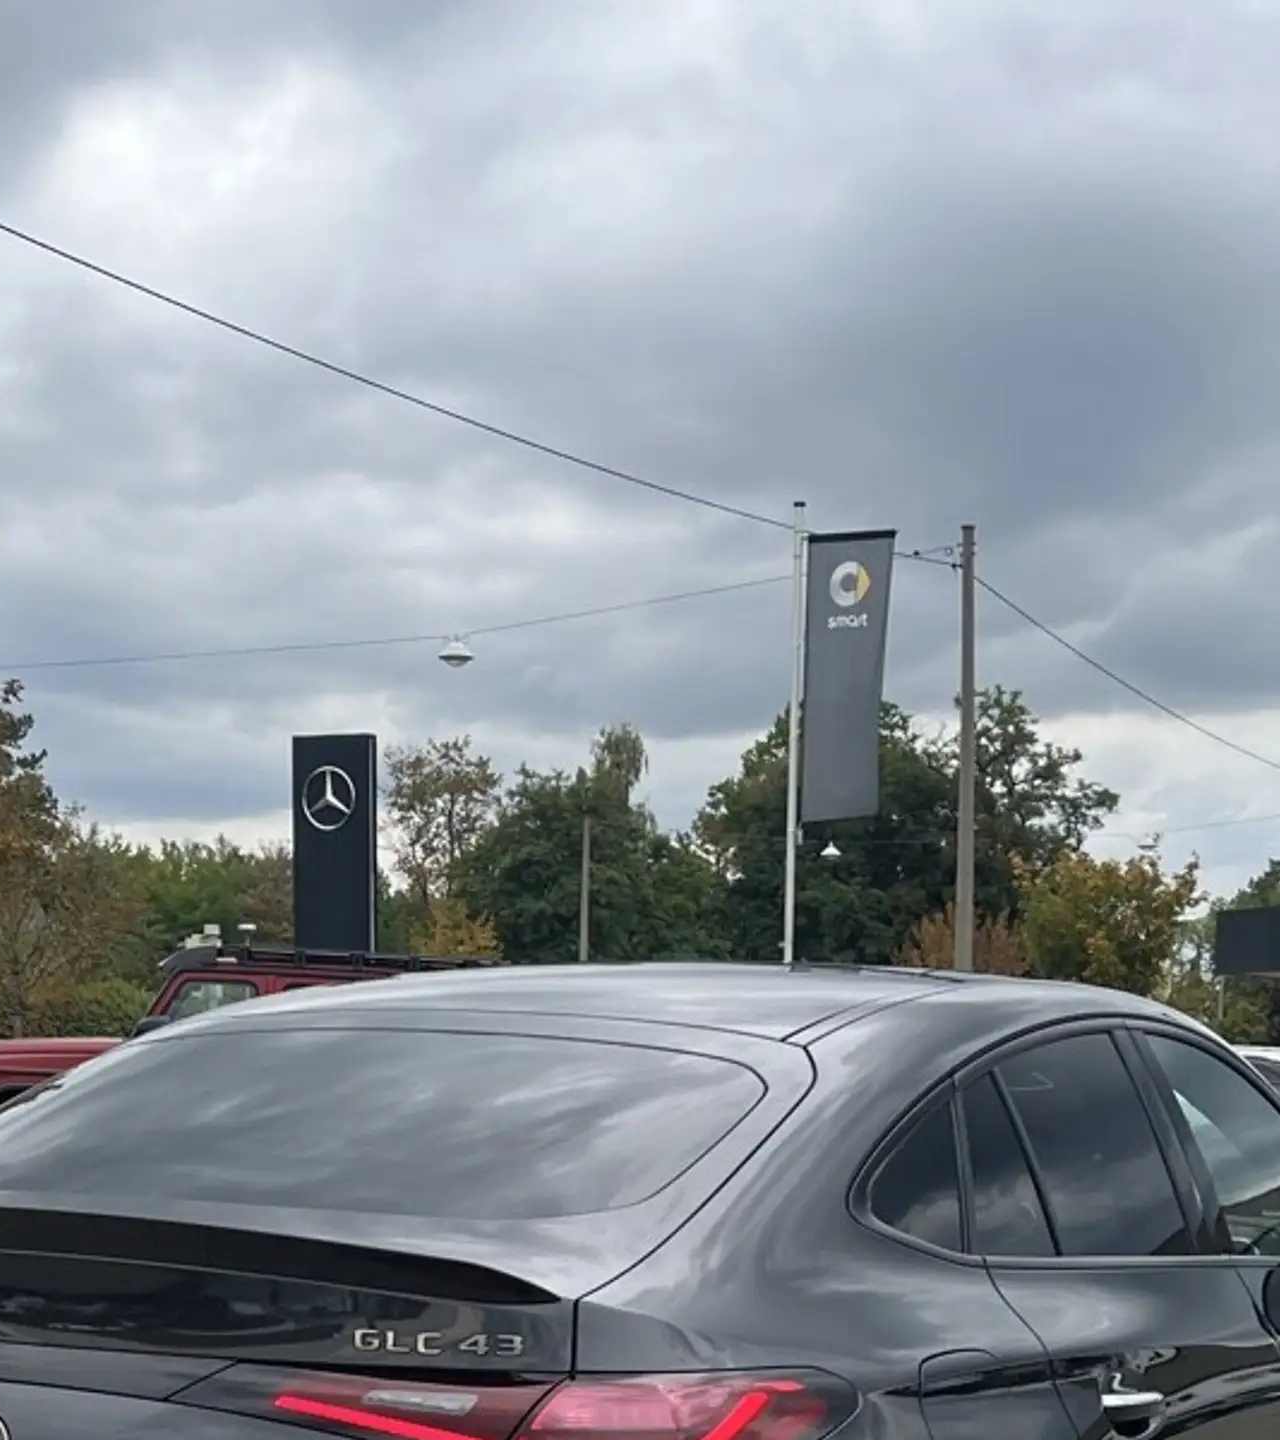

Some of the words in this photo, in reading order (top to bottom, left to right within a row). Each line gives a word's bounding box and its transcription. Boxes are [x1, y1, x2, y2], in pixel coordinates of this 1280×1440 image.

[827, 613, 869, 630] smart
[353, 1327, 444, 1356] GLC
[458, 1333, 525, 1356] 43
